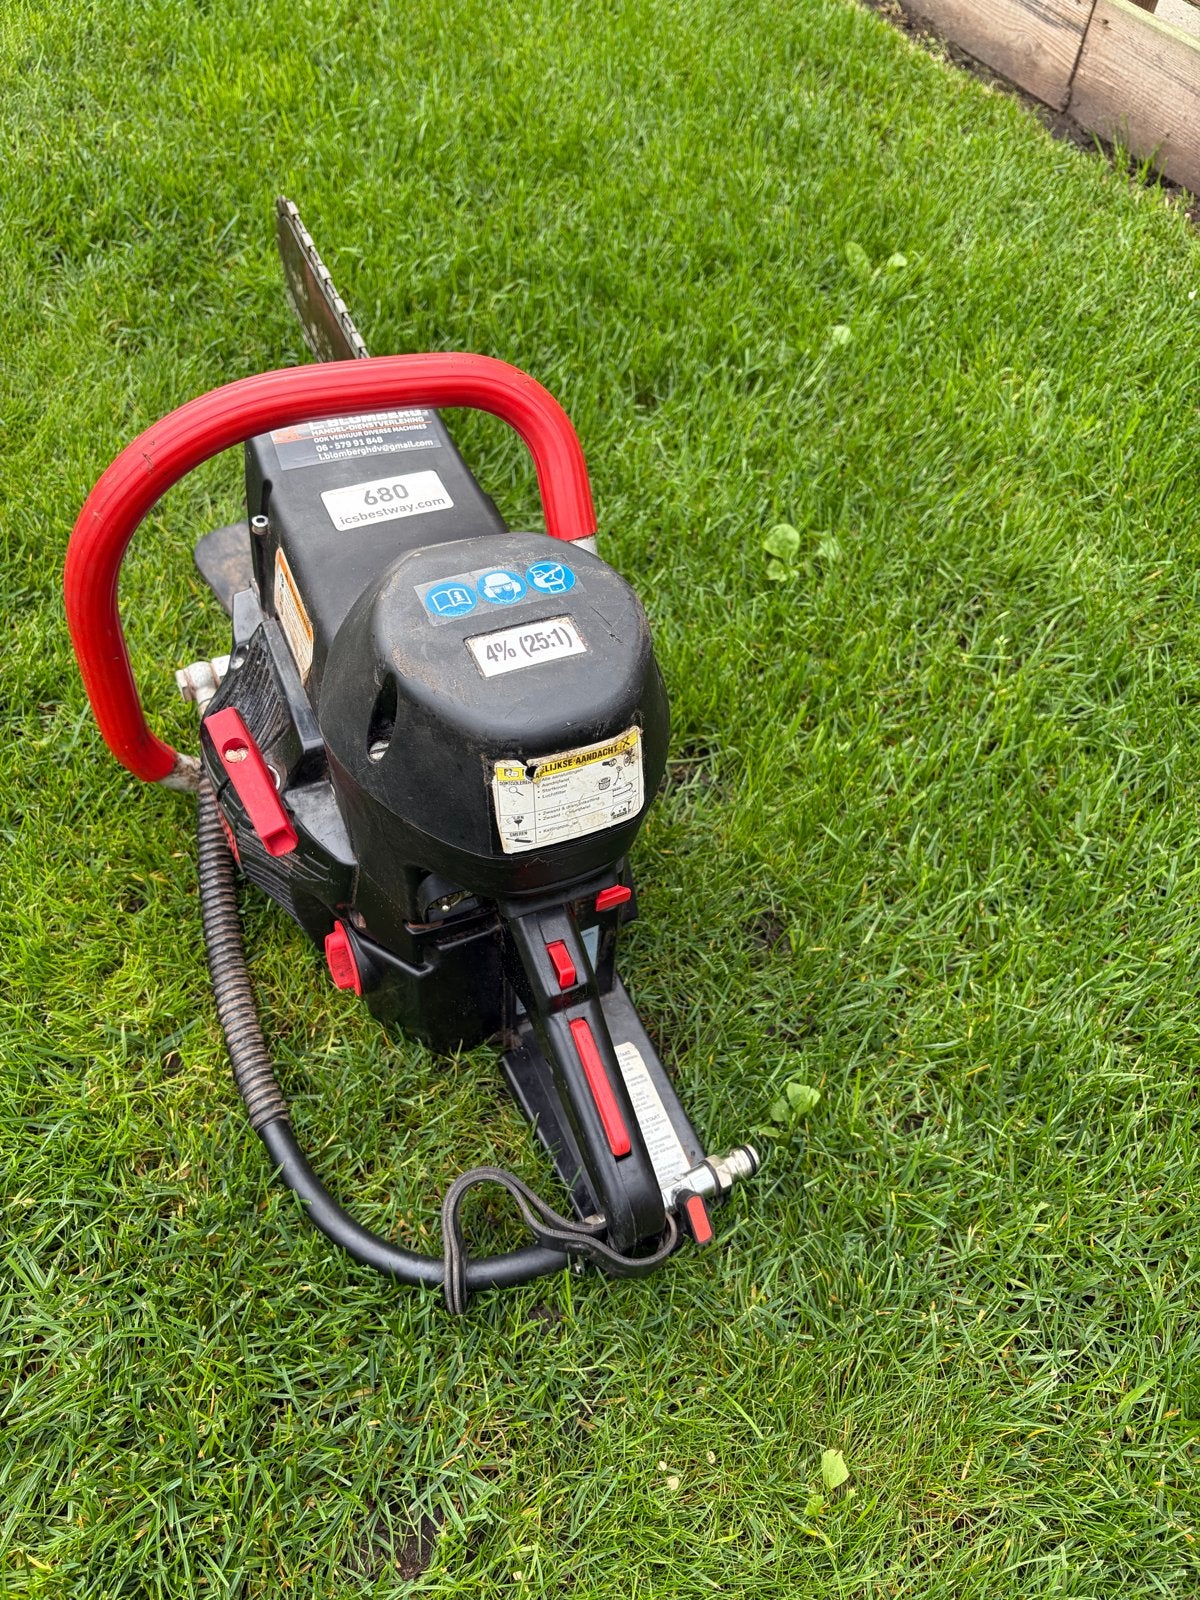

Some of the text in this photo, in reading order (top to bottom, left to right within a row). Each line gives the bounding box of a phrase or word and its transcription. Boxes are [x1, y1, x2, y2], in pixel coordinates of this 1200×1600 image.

[311, 416, 425, 436] HANDEL-DIENSTVERLENING
[314, 423, 428, 444] OOK VERHUUR DIVERSE MACHINES
[315, 443, 329, 453] 06
[335, 440, 352, 450] 579
[352, 438, 365, 447] 91
[365, 436, 384, 446] 848
[363, 484, 409, 506] 680
[340, 497, 446, 525] icsbestway.com
[485, 626, 573, 663] 4% (25:1)
[575, 744, 618, 765] AANDACHT
